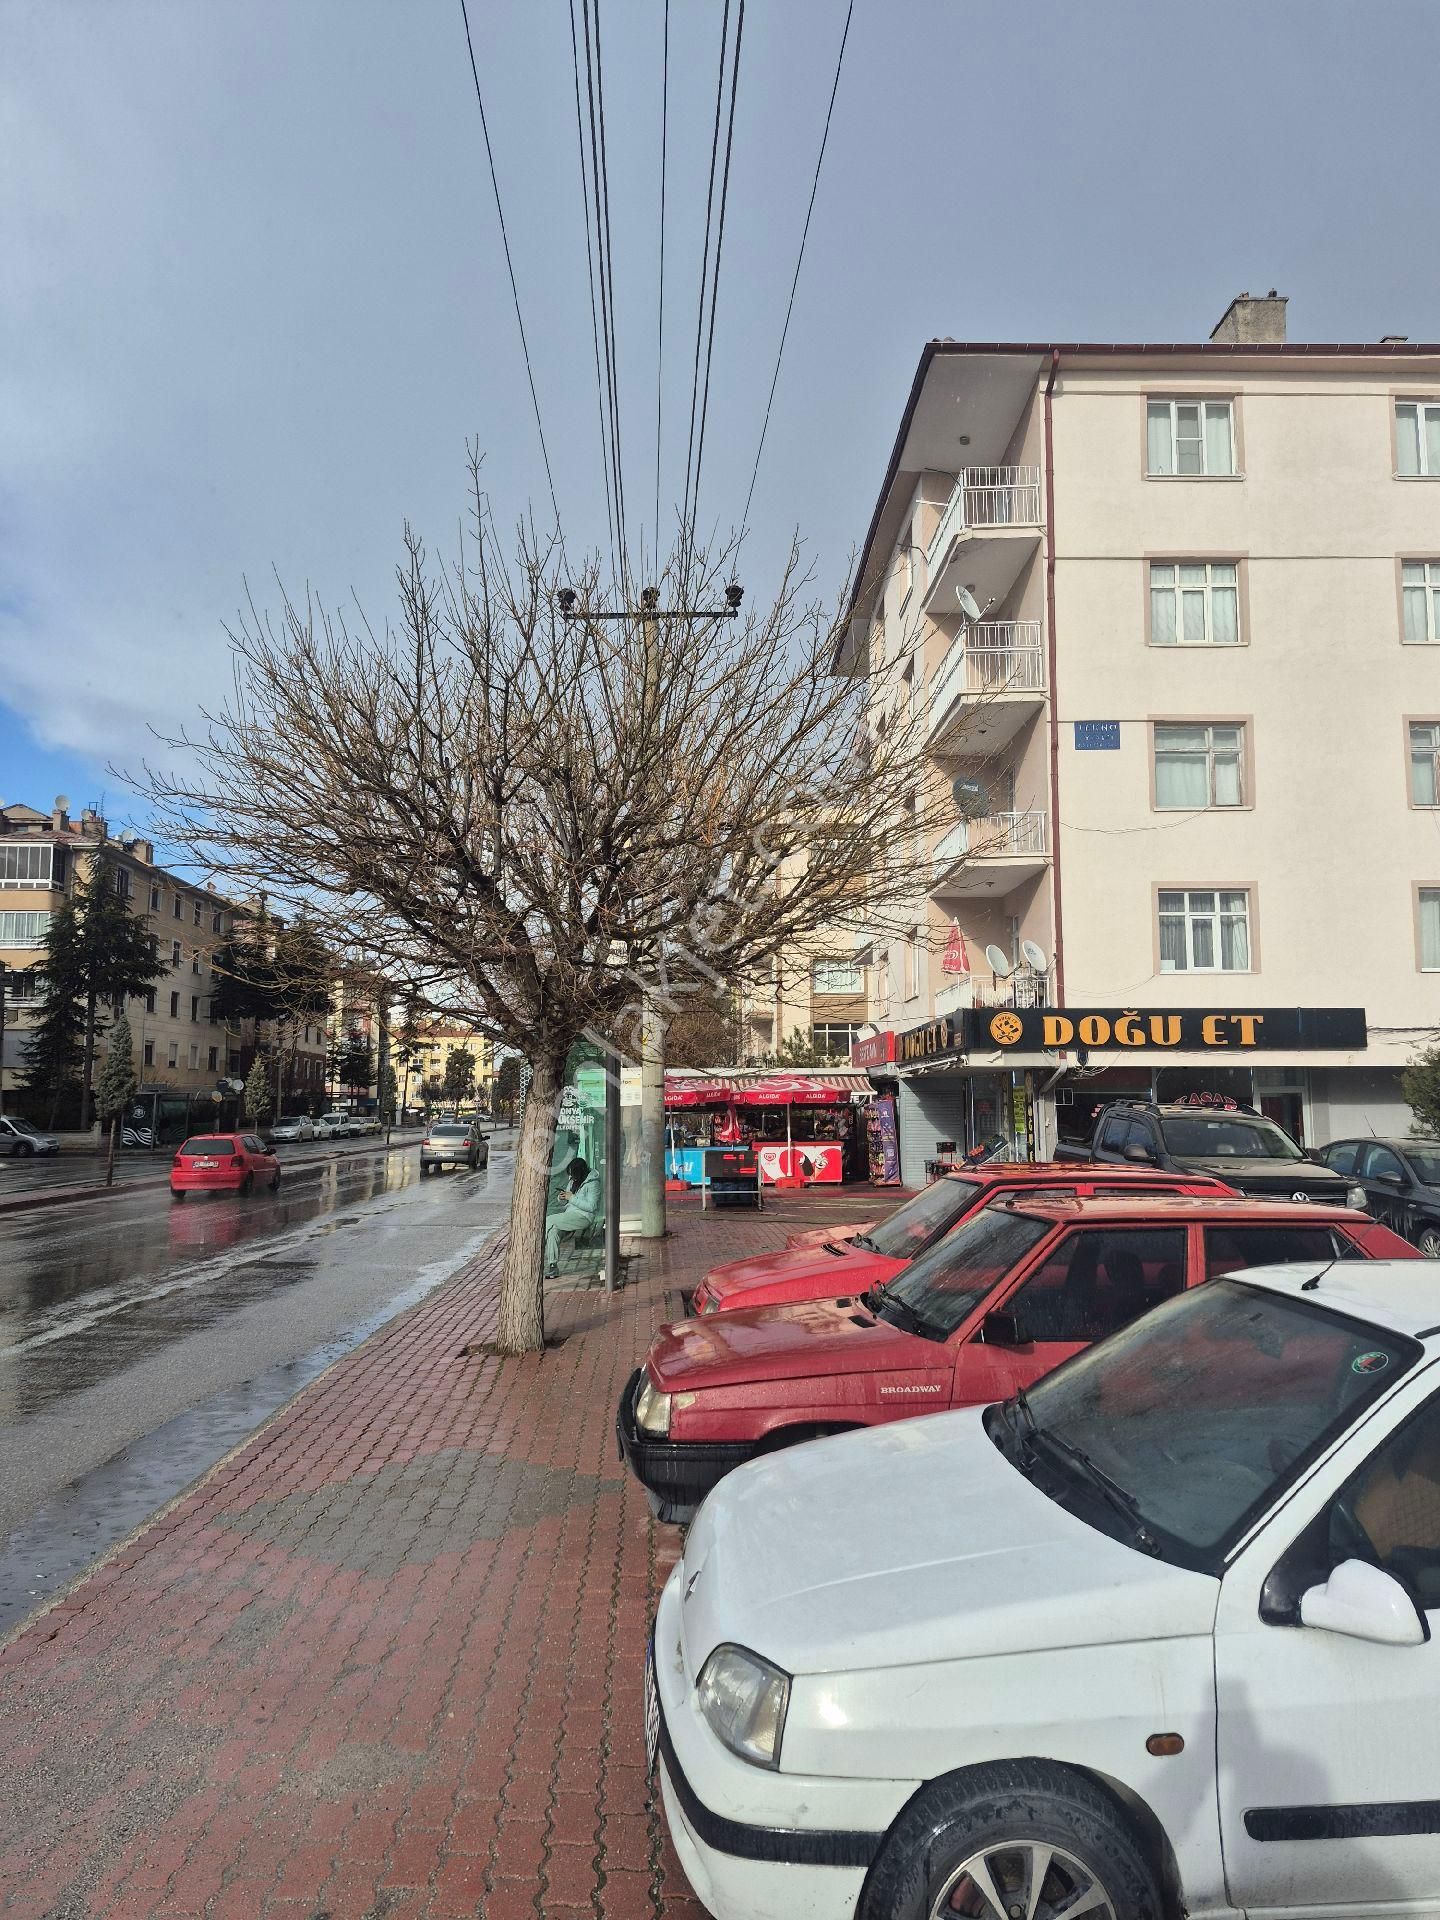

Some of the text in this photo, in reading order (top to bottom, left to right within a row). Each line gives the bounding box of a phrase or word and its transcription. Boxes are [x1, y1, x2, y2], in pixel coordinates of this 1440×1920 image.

[1042, 1010, 1264, 1046] DOĞU ET
[560, 1107, 582, 1115] ONYA
[880, 1384, 941, 1394] BROADWAY
